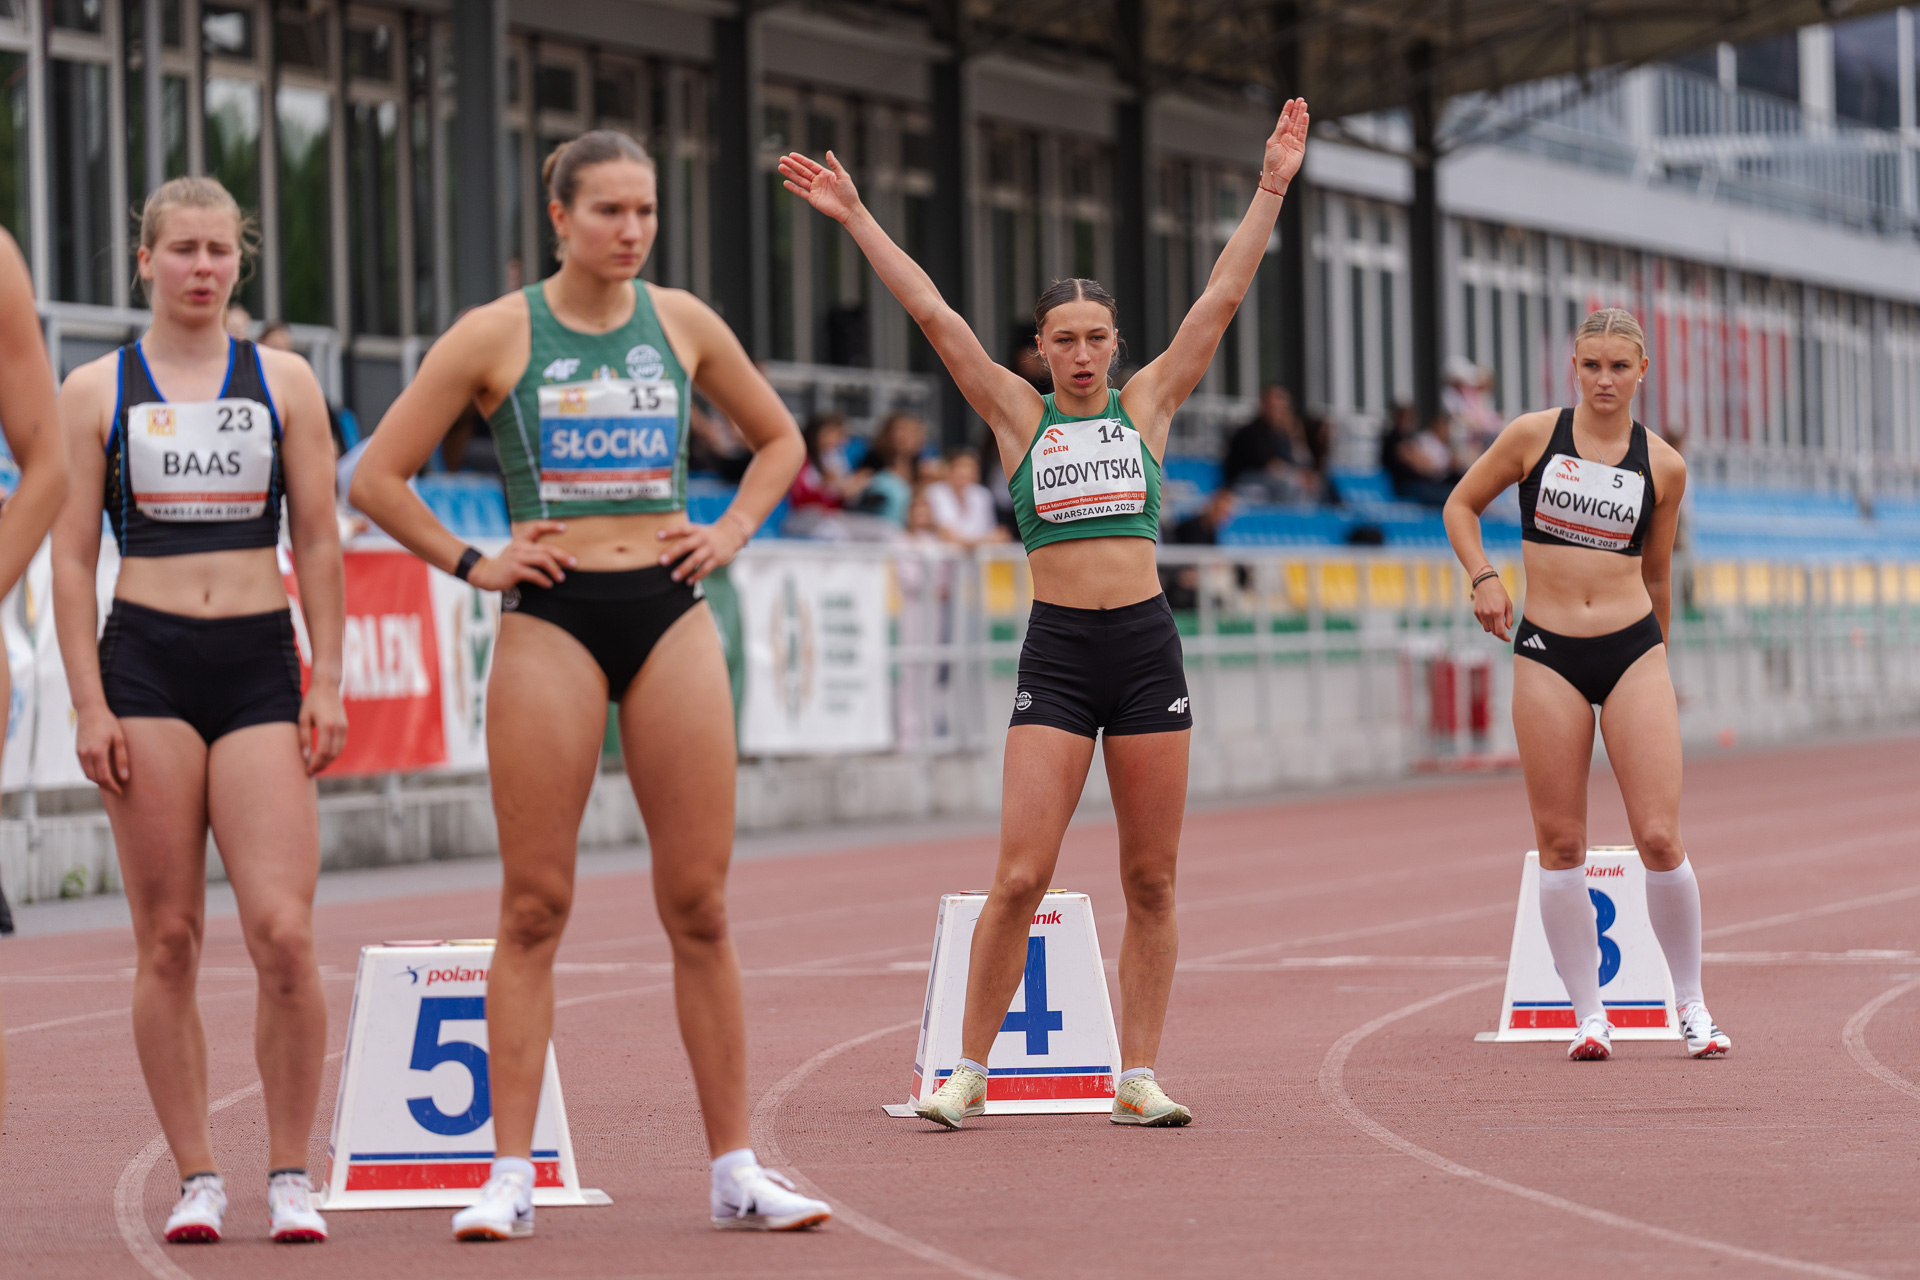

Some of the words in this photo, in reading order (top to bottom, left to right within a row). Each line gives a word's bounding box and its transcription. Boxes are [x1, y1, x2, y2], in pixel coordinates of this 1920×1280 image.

[630, 386, 661, 410] 15
[217, 407, 253, 432] 23
[551, 428, 669, 459] SŁOCKA
[1098, 424, 1125, 443] 14
[1043, 445, 1069, 456] ORLEN
[163, 451, 241, 476] BAAS
[1036, 458, 1142, 491] LOZOVYTSKA
[1556, 472, 1580, 483] ORLEN
[1612, 473, 1624, 489] 5
[1053, 505, 1113, 520] WARSZAWA
[1114, 503, 1135, 512] 2025
[1542, 487, 1634, 524] NOWICKA
[1545, 524, 1596, 545] WARSZAWA
[1597, 540, 1618, 548] 2025
[344, 613, 431, 699] RLEN
[1167, 696, 1189, 714] 4F
[1584, 864, 1625, 877] olanik
[998, 936, 1063, 1056] 4
[406, 996, 493, 1137] 5
